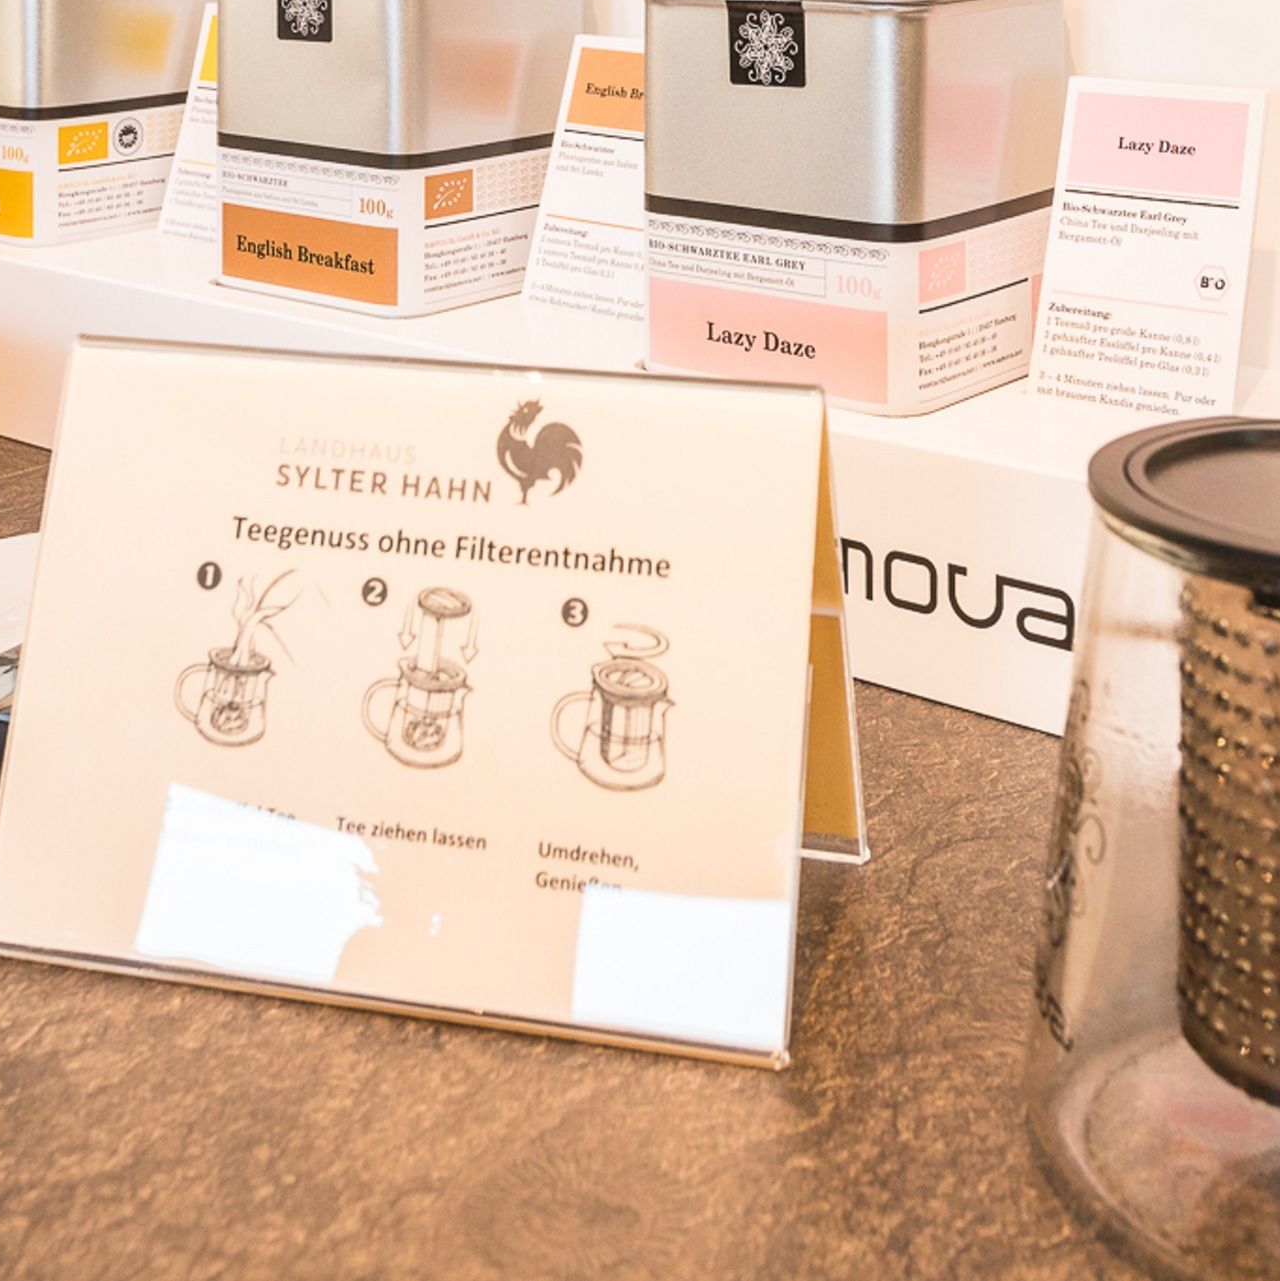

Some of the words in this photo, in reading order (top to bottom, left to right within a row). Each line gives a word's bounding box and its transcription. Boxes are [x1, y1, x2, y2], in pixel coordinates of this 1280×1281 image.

[585, 82, 628, 98] English
[1117, 136, 1155, 155] Lazy
[1158, 139, 1197, 157] Daze
[357, 197, 394, 220] 100g
[1062, 201, 1138, 219] Bio-Schwarztee
[1139, 209, 1162, 221] Earl
[1163, 212, 1189, 226] Grey
[1090, 219, 1109, 230] Tee
[1110, 222, 1128, 232] und
[1130, 223, 1181, 240] Darjeeling
[236, 233, 293, 261] English
[297, 244, 376, 276] Breakfast
[648, 237, 741, 262] BIO-SCHWARZTEE
[742, 250, 773, 266] EARL
[774, 257, 806, 272] GREY
[835, 271, 882, 301] 100g
[705, 320, 757, 352] Lazy
[763, 329, 817, 360] Daze
[1092, 323, 1110, 334] pro
[1139, 327, 1171, 342] Kanne
[1140, 359, 1156, 370] pro
[1141, 345, 1158, 356] pro
[1159, 345, 1192, 360] Kanne
[1063, 373, 1104, 390] Minuten
[1173, 389, 1193, 403] Pur
[1194, 394, 1217, 408] oder
[1098, 393, 1134, 409] Kandis
[279, 436, 418, 464] LANDHAUS
[275, 464, 388, 496] SYLTER
[400, 474, 493, 505] HAHN
[231, 515, 371, 553] Teegenuss
[377, 529, 447, 559] ohne
[454, 535, 672, 580] Filterentnahme
[835, 536, 1076, 652] mova
[336, 815, 367, 834] Tee
[371, 823, 428, 844] ziehen
[432, 827, 488, 851] lassen
[537, 840, 640, 873] Umdrehen,
[535, 870, 623, 893] Genie
